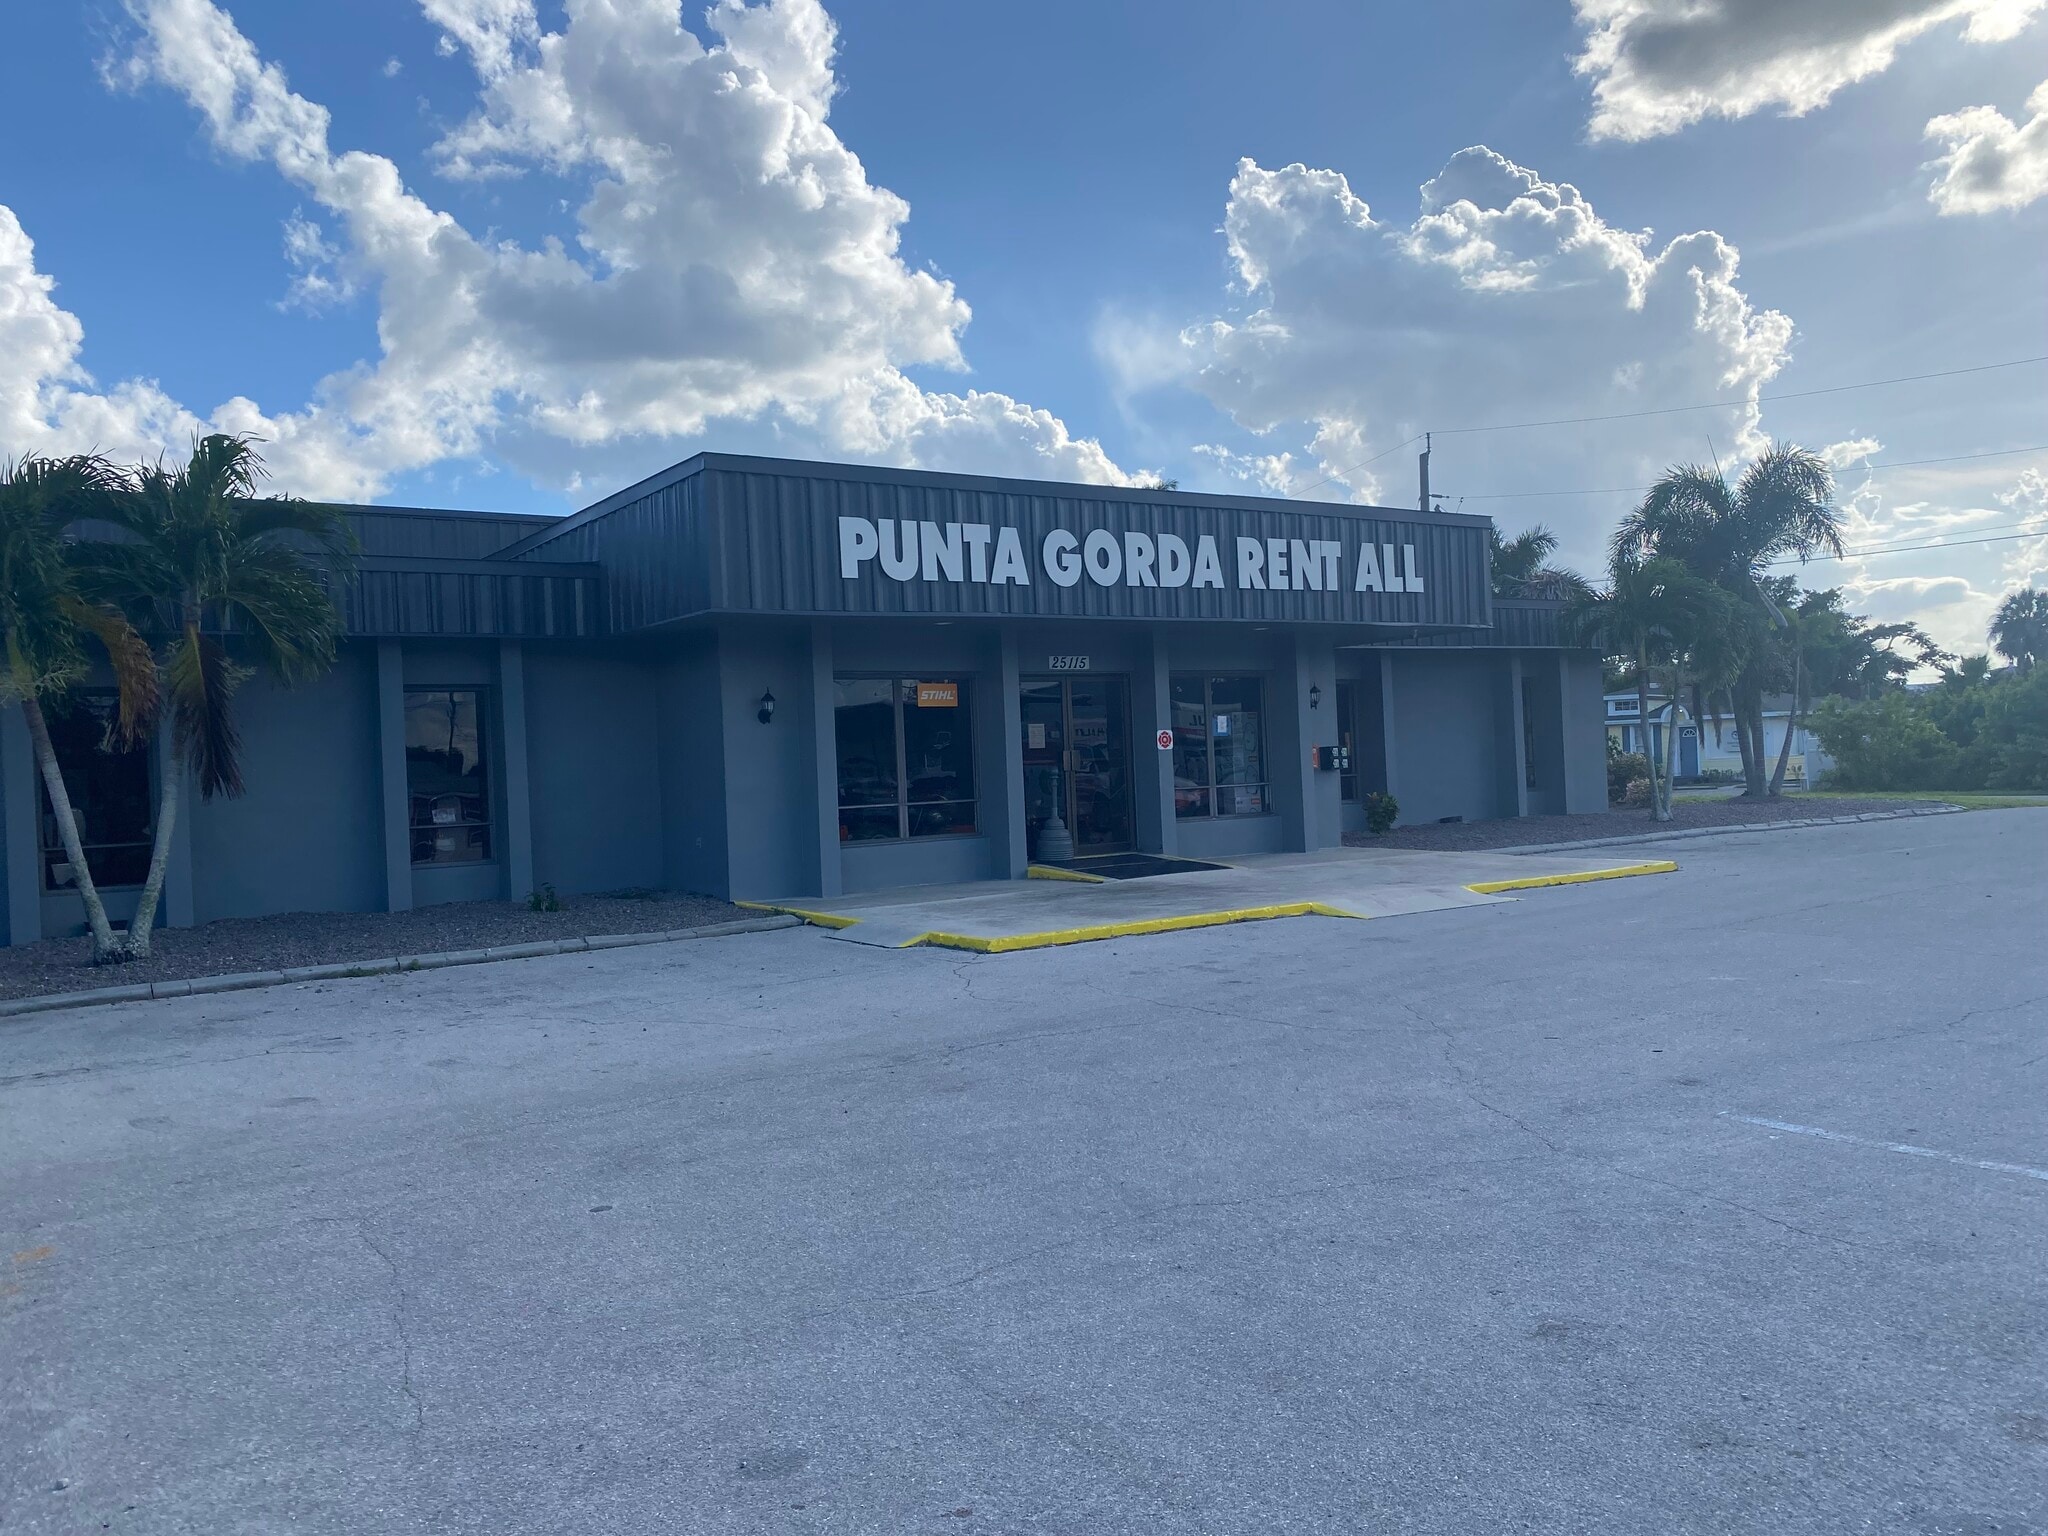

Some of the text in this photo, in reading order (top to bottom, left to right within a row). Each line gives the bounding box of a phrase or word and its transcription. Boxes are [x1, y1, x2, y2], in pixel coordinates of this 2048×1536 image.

[838, 516, 1425, 593] PUNTA GORDA RENT ALL
[1051, 656, 1087, 669] 25115
[920, 690, 954, 700] STIHL
